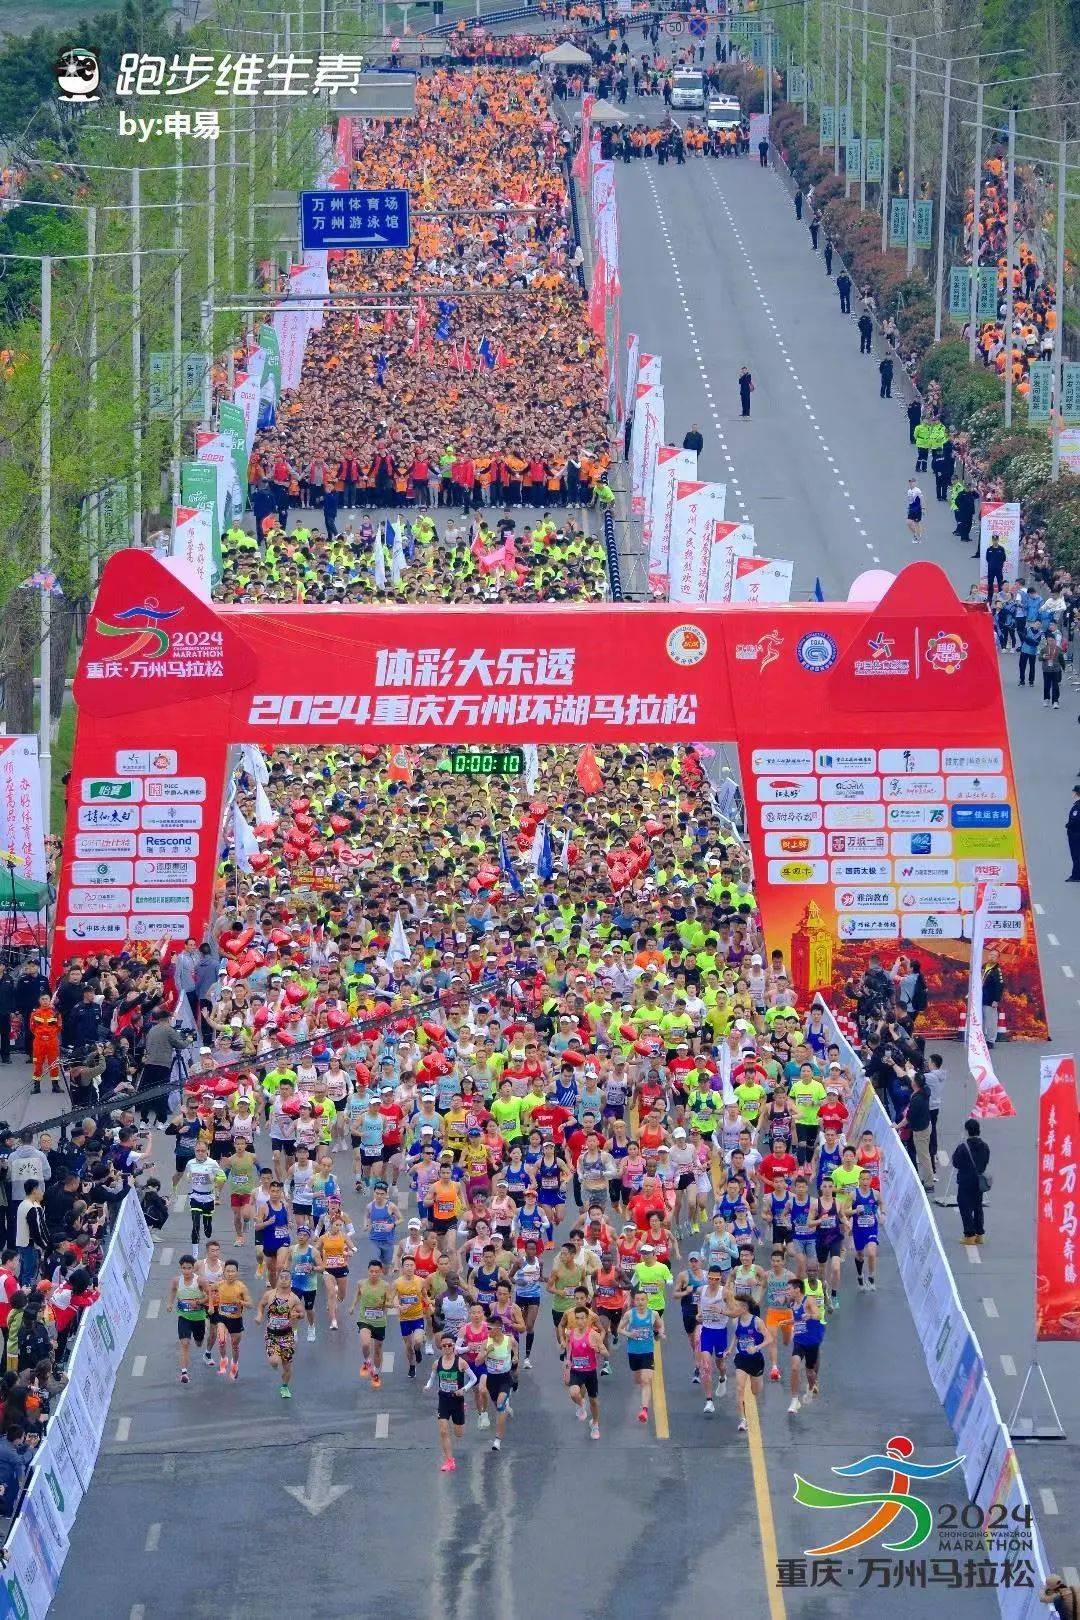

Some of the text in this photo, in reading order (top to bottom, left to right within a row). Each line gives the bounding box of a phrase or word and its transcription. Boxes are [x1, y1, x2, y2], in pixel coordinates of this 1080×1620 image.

[312, 197, 398, 212] 万州体育场
[312, 214, 399, 230] 万州游泳馆
[172, 631, 224, 647] 2024
[173, 650, 224, 658] MARATHON
[86, 661, 224, 679] 重庆·万州马拉松
[375, 648, 576, 687] 体彩大乐透
[248, 694, 698, 727] 2024重庆万州环湖马拉松
[455, 755, 520, 772] 0:00:10
[146, 836, 192, 846] Rescond
[845, 867, 877, 875] 国药太极
